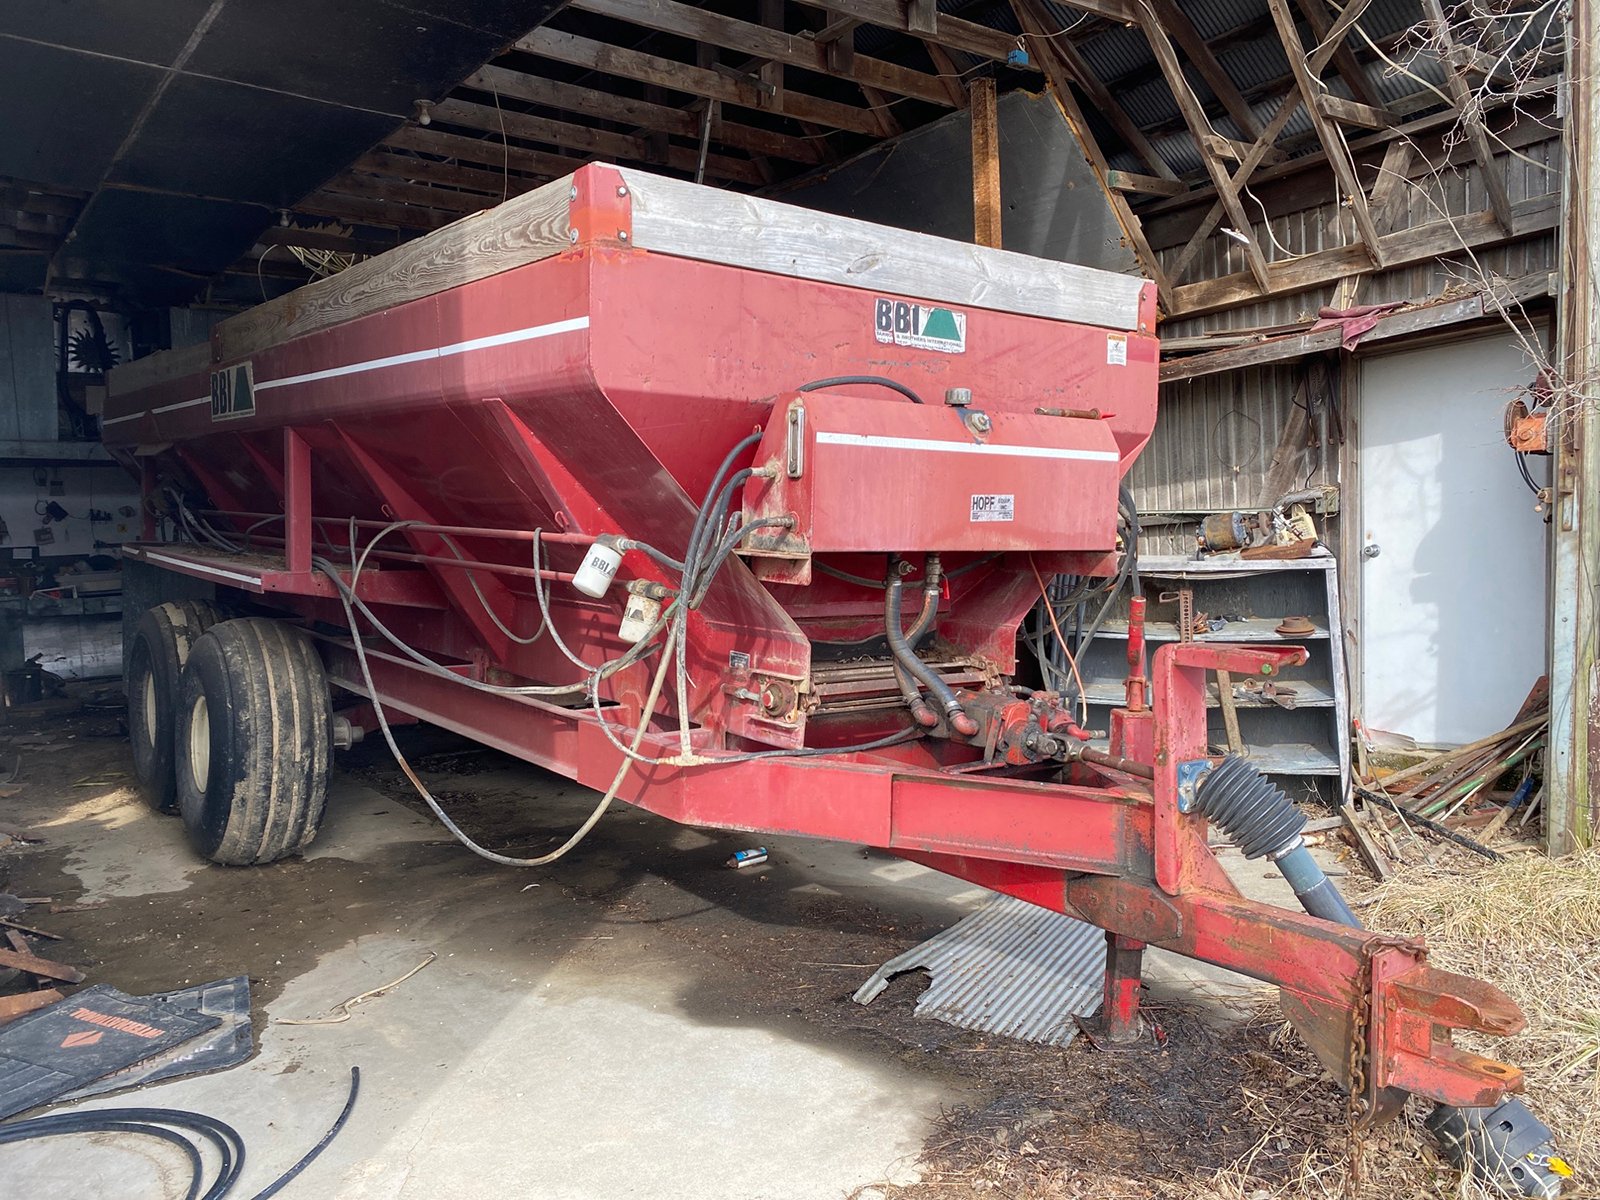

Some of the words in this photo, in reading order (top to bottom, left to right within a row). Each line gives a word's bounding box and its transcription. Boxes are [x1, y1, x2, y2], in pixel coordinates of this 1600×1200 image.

[876, 299, 920, 335] BBI
[211, 369, 232, 415] BBI
[972, 496, 995, 510] HOPF
[591, 557, 610, 572] BBI
[69, 1007, 167, 1039] INTERNATIONAL
